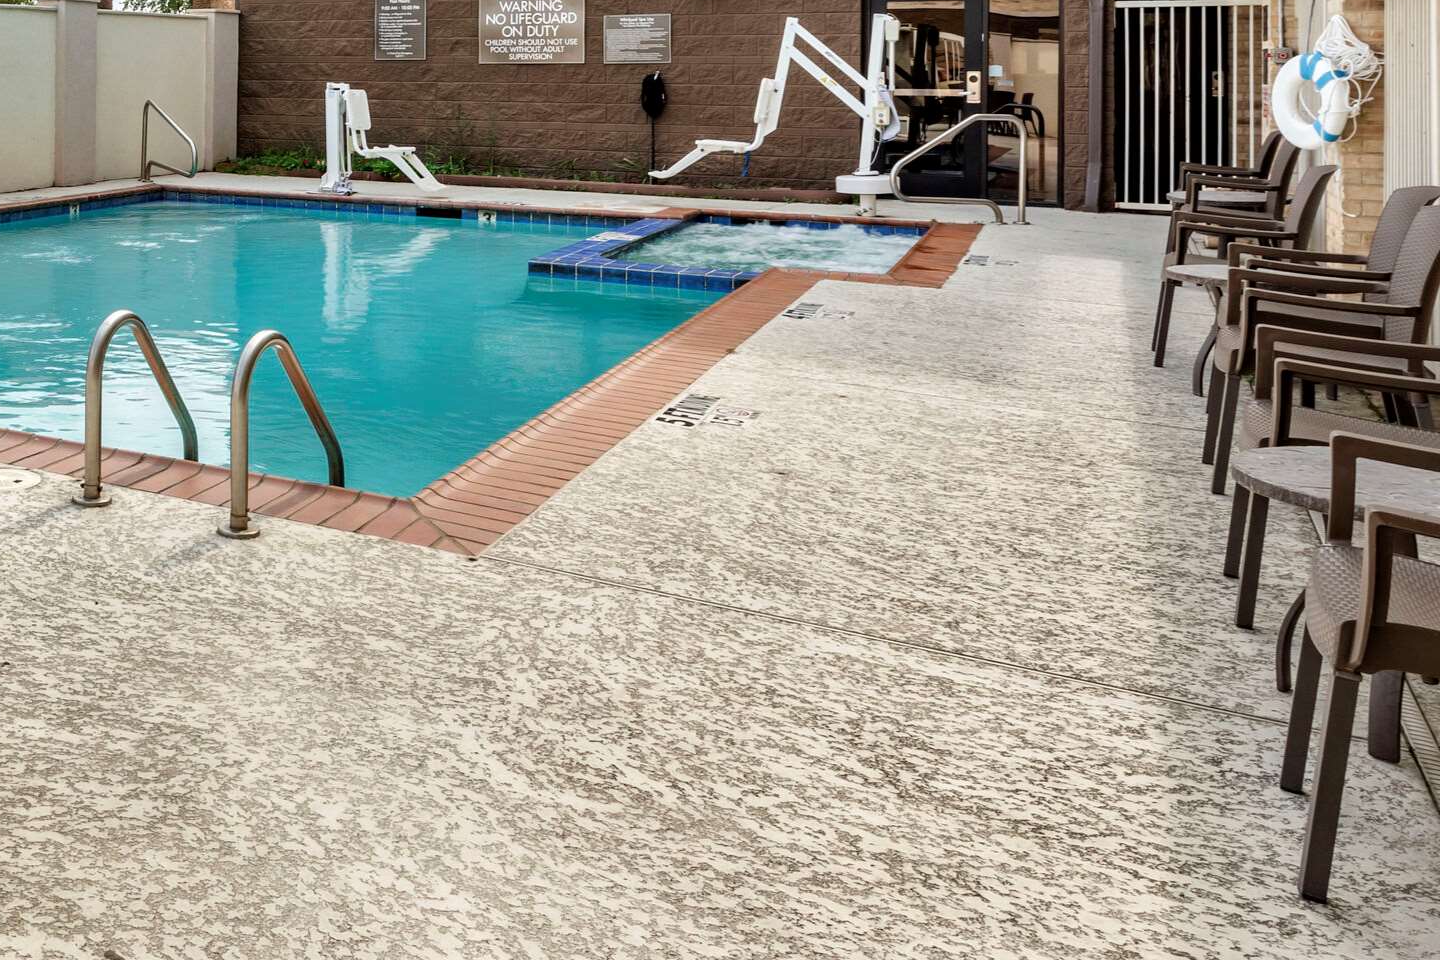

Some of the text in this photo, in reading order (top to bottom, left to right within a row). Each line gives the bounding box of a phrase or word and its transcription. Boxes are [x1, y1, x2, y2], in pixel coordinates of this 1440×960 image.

[499, 0, 563, 13] WARNING
[485, 12, 578, 25] NO LIFEGUARD
[501, 25, 559, 38] ON DUTY
[485, 39, 517, 47] CHILDREN
[564, 38, 579, 46] USE
[508, 53, 553, 61] SUPERVISION
[655, 407, 705, 428] 5 FT
